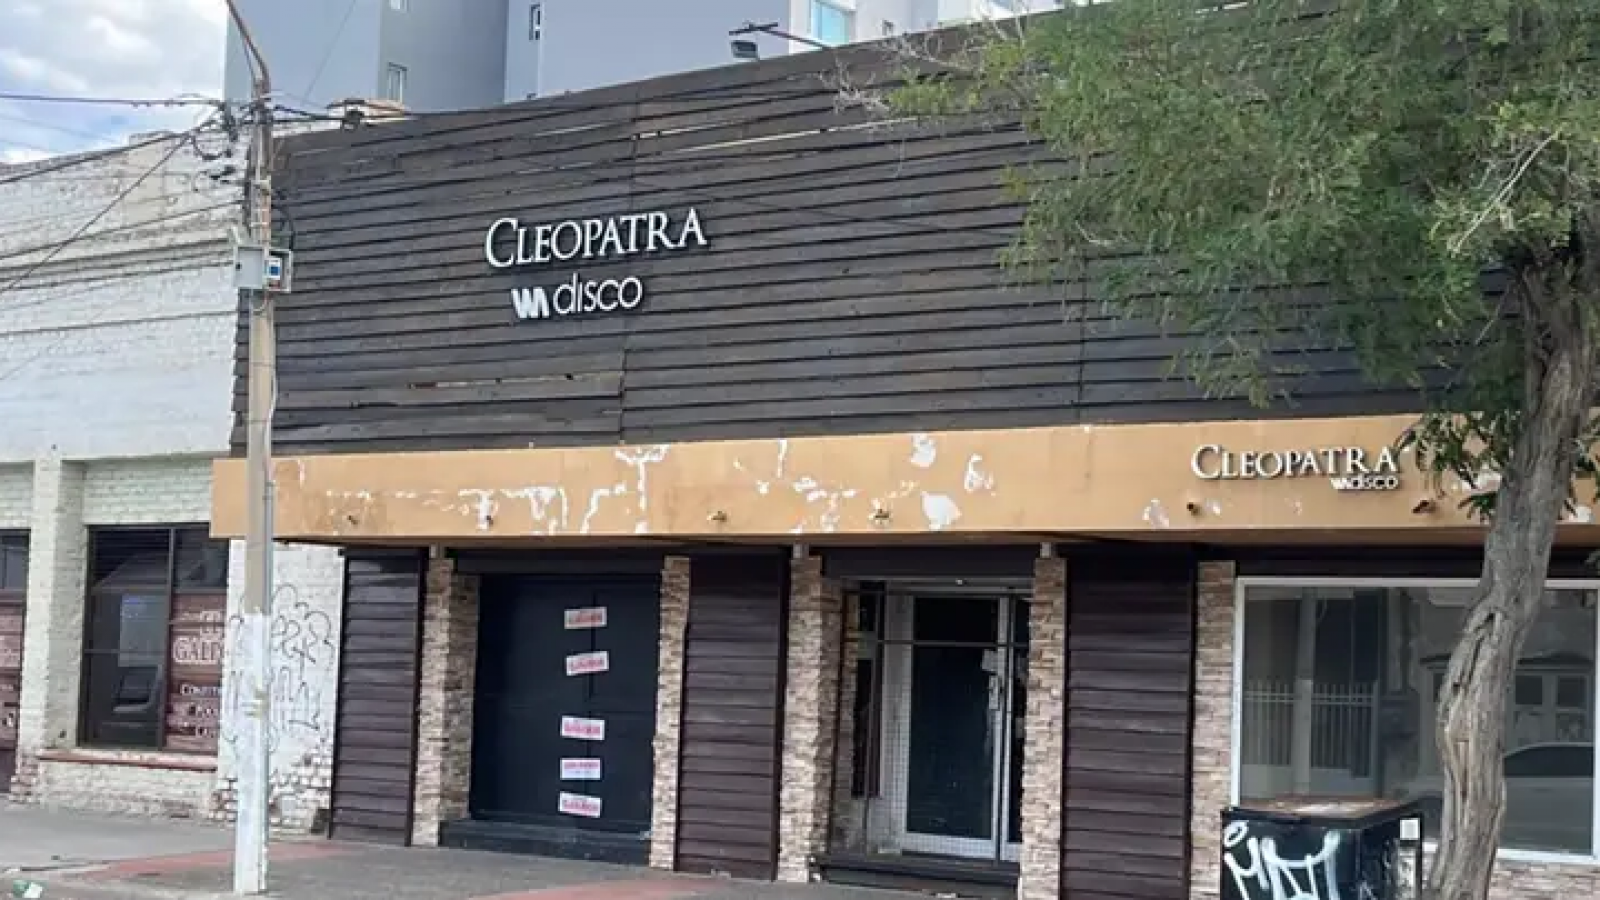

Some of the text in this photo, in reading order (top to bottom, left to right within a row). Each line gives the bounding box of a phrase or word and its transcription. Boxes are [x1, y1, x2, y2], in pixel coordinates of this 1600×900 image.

[486, 207, 708, 268] CLEOPATRA
[552, 272, 643, 315] disco
[1191, 443, 1398, 479] CLEOPATRA
